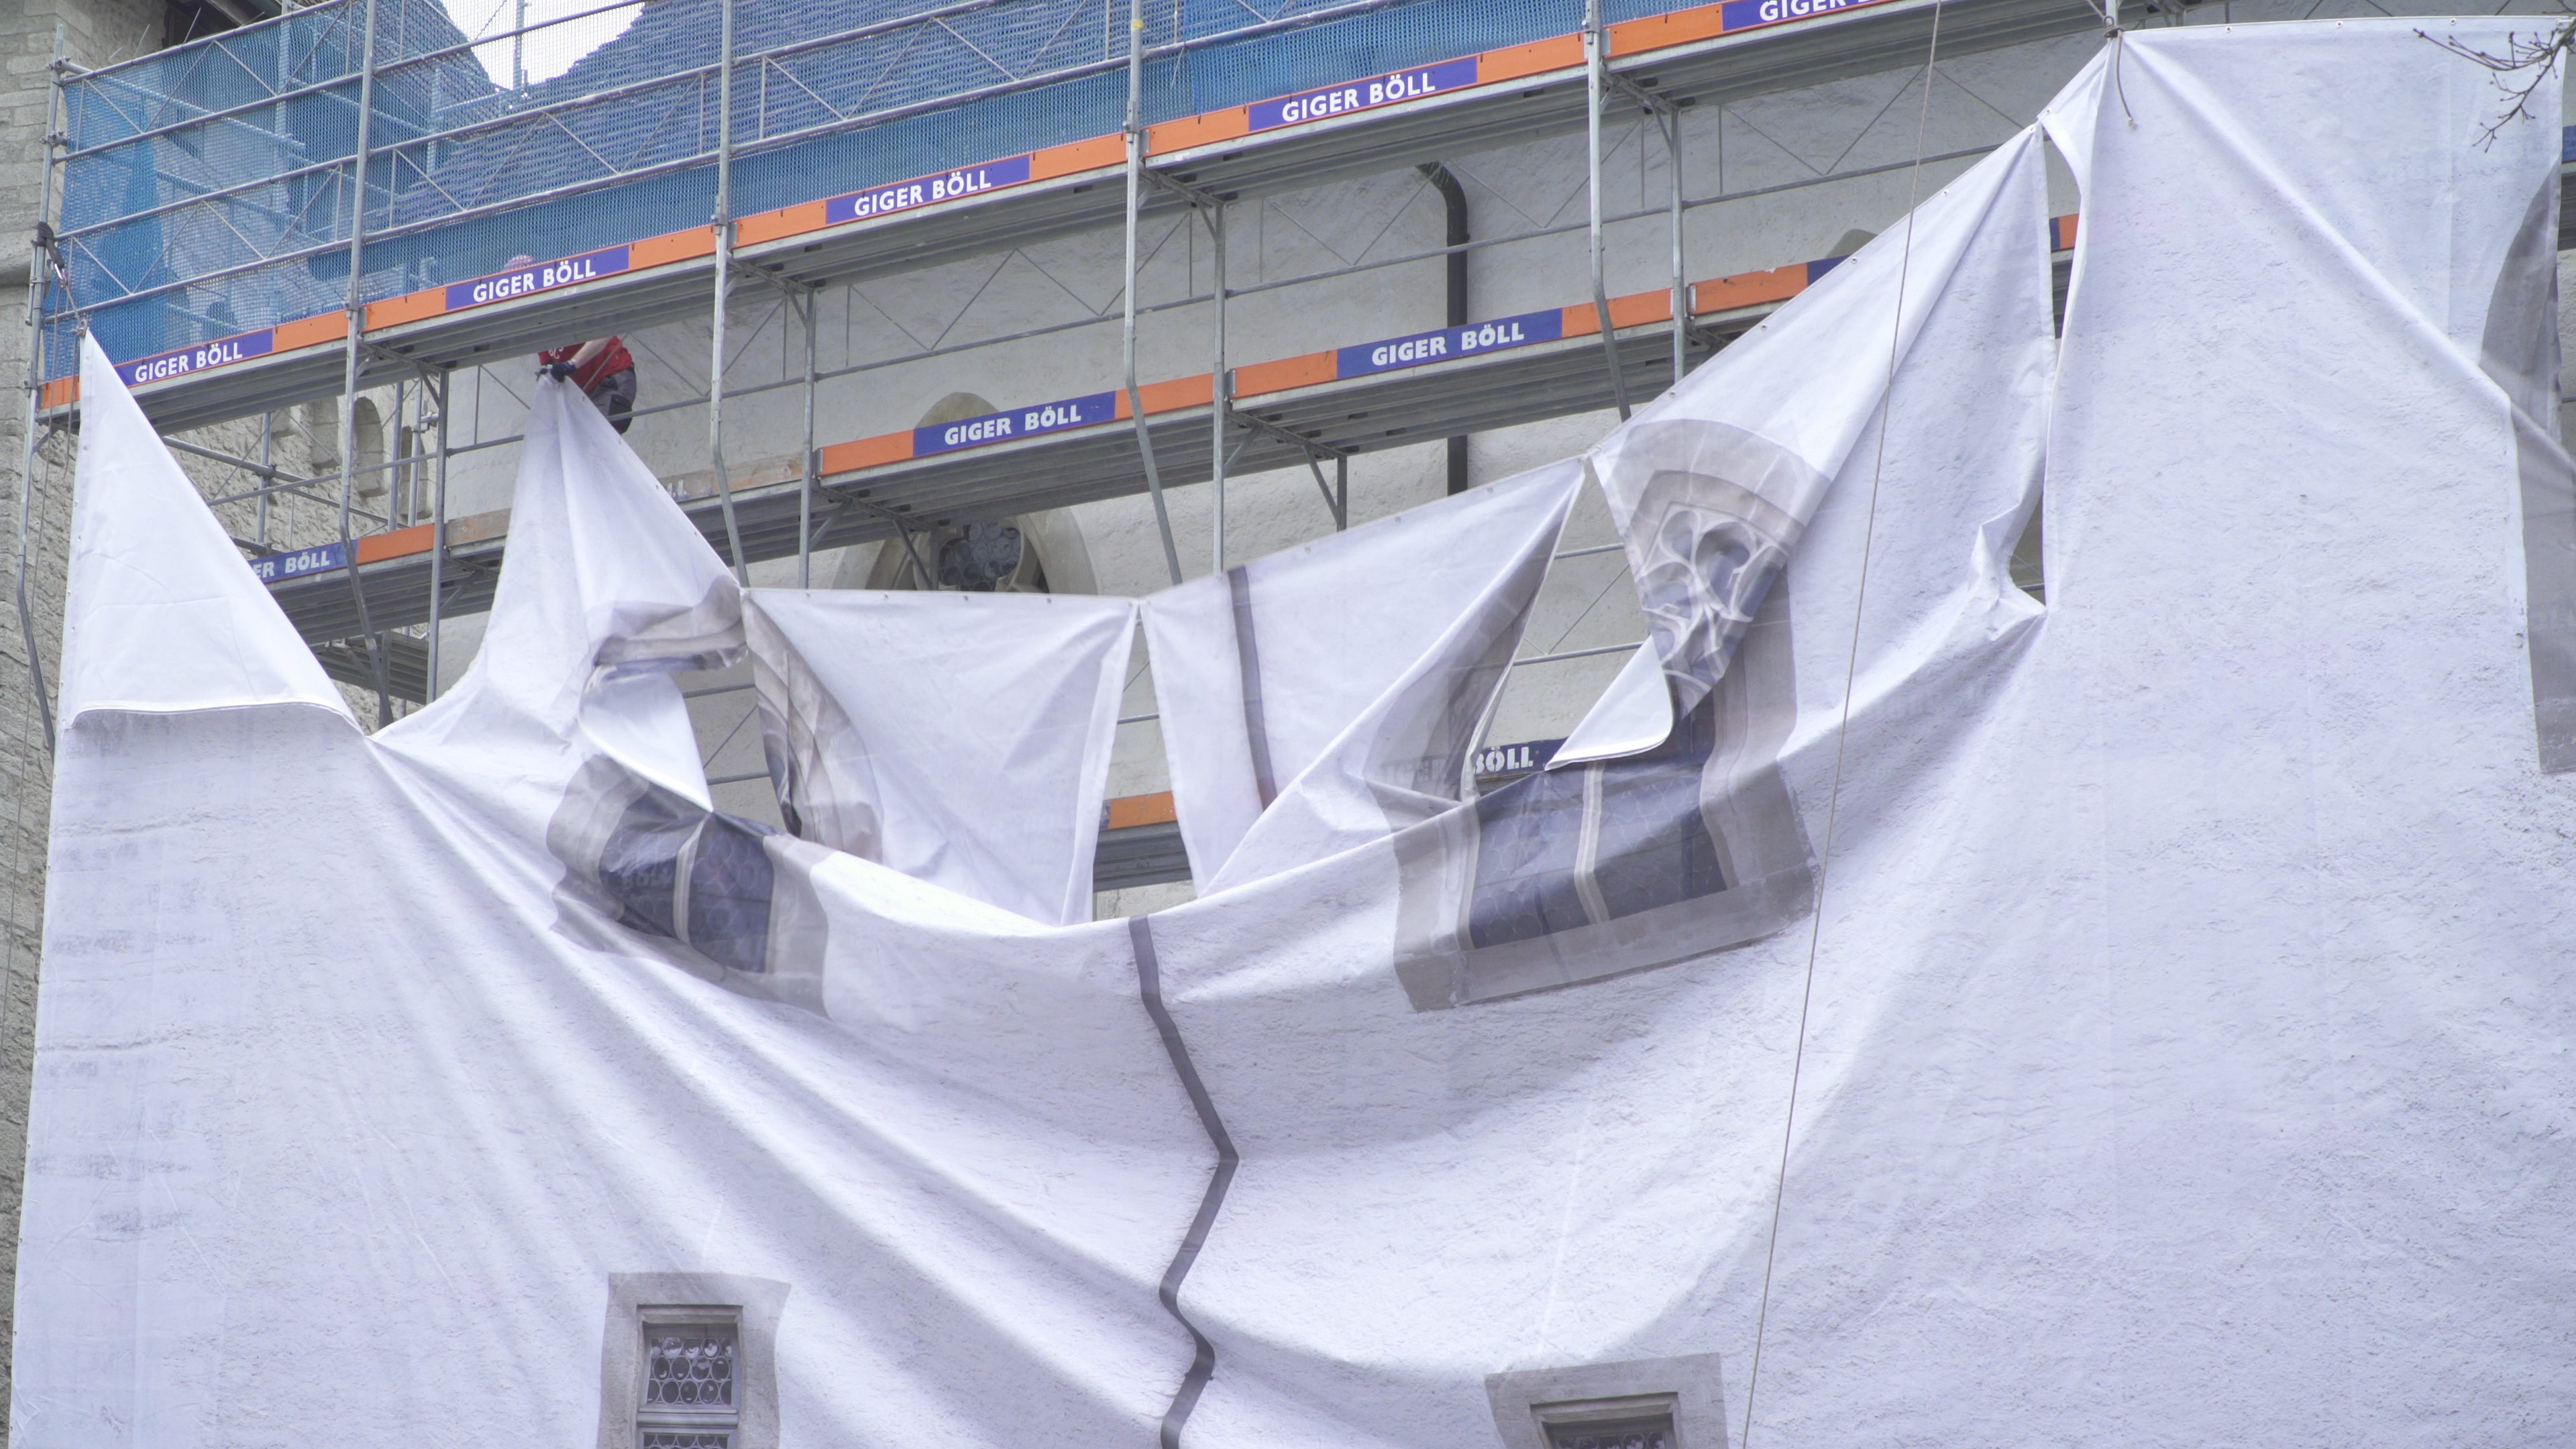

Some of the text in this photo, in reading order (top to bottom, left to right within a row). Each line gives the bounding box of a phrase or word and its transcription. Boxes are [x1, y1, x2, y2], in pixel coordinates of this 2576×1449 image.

[1282, 72, 1436, 122] GIGER BÖLL
[854, 170, 991, 216] GIGER BÖLL
[473, 259, 596, 302] GIGER BÖLL
[135, 342, 243, 382] GIGER BÖLL
[1372, 322, 1524, 366] GIGER BÖLL
[945, 405, 1081, 445] GIGER BÖLL
[284, 550, 330, 574] BÖLL
